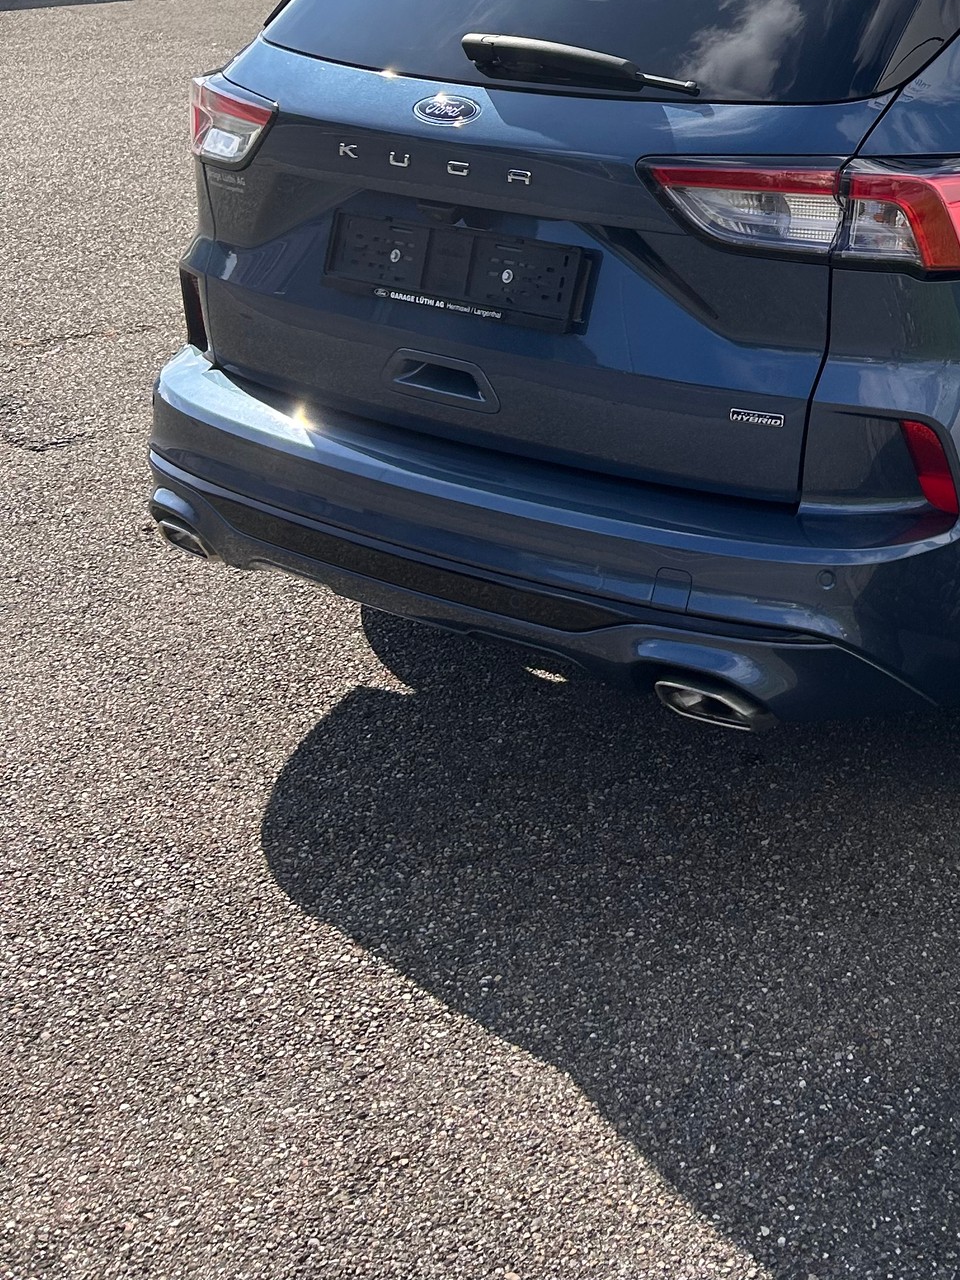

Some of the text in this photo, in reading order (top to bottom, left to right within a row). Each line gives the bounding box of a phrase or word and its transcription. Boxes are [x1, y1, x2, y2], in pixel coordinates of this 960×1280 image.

[339, 142, 532, 185] KUGA
[390, 291, 415, 303] GARAGE
[415, 295, 435, 306] LÜTHI
[435, 300, 445, 308] AG
[474, 307, 502, 319] Langenthal
[732, 413, 781, 426] HYBRID
